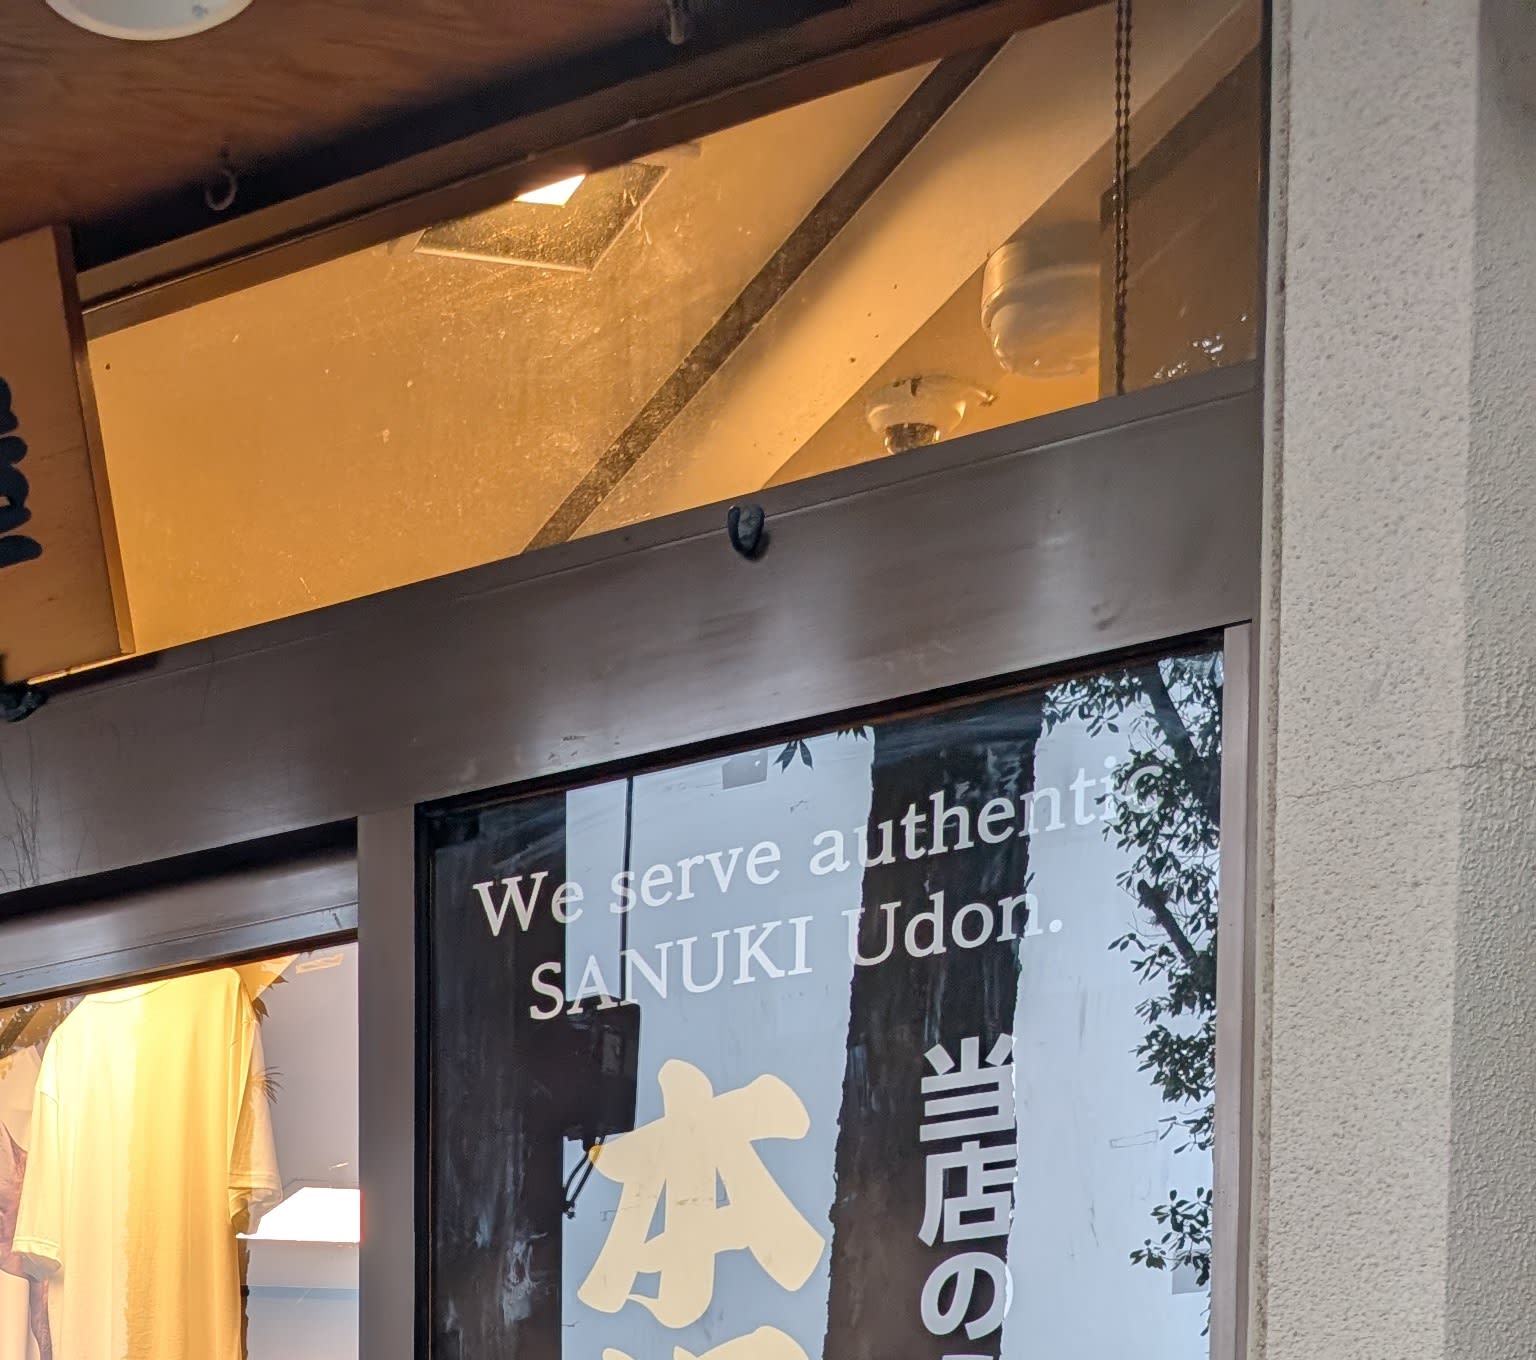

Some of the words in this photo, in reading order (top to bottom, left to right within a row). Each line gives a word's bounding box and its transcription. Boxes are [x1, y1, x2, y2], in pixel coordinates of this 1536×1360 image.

[474, 870, 585, 937] We
[610, 838, 782, 915] serve
[810, 755, 1164, 876] authentic
[530, 913, 814, 1020] SANUKI
[841, 889, 1063, 968] Udon.
